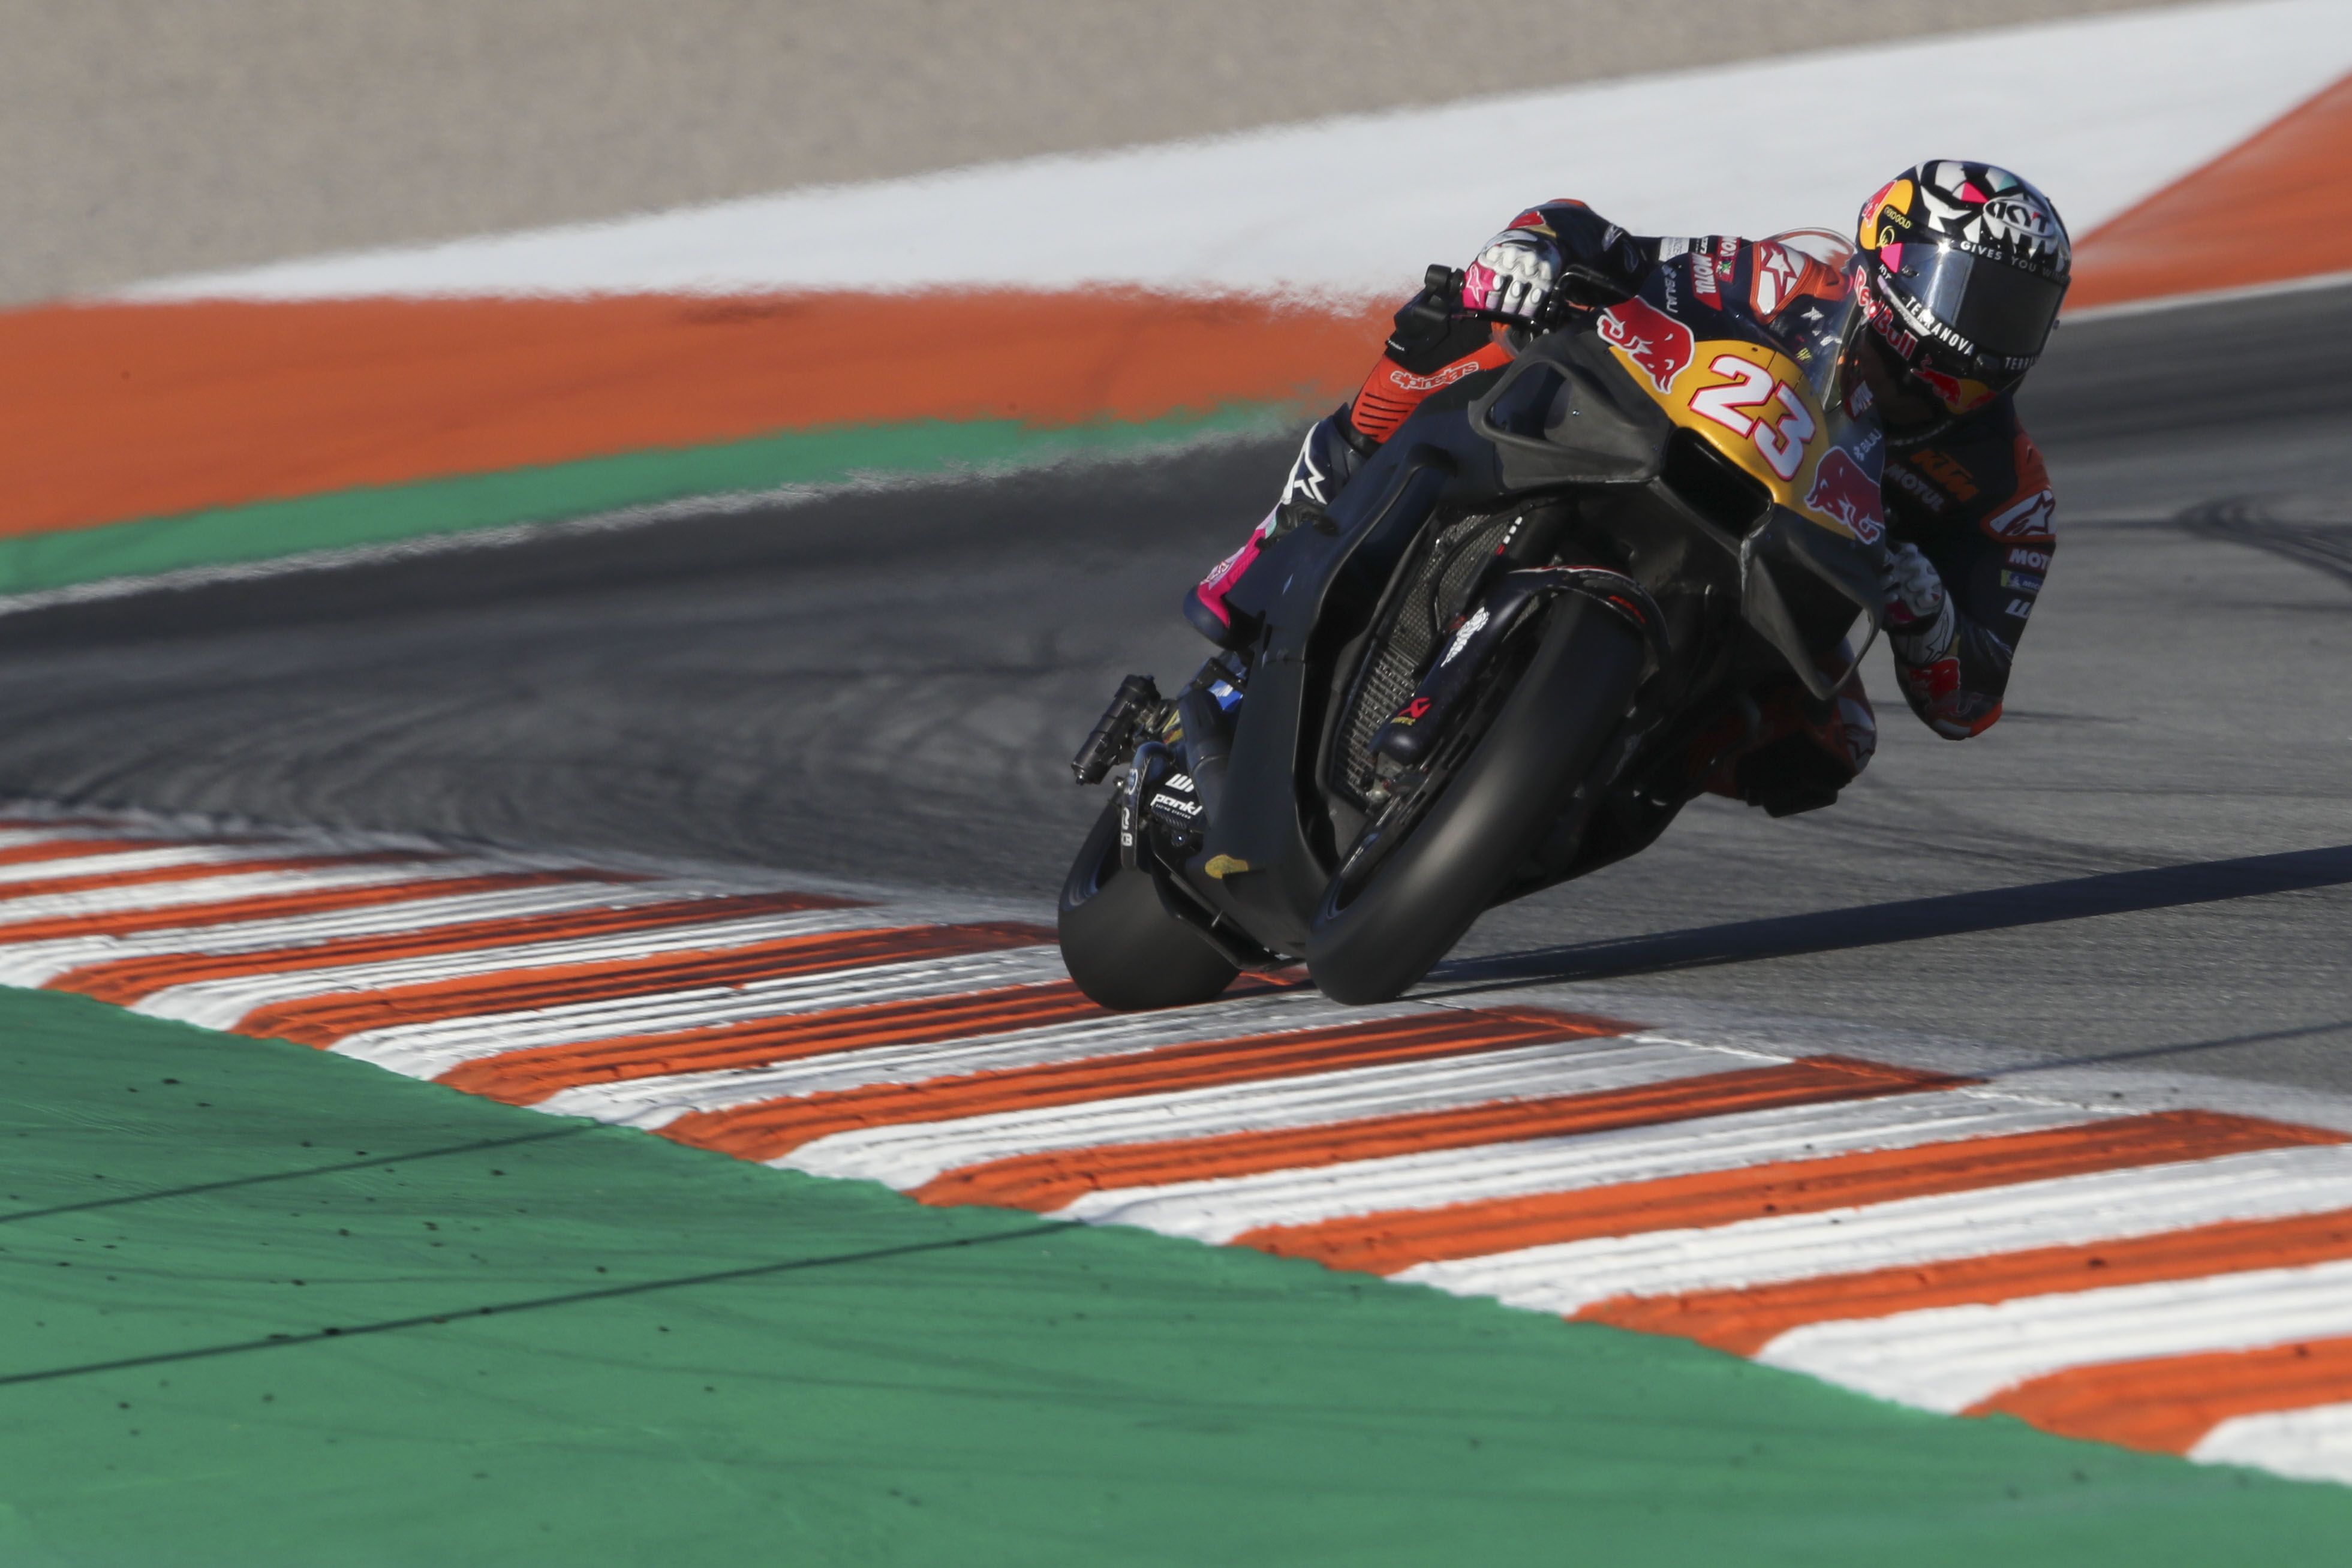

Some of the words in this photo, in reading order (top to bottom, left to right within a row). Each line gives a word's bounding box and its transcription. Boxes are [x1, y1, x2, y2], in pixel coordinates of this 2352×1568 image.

[1691, 252, 1716, 294] MOTUL
[1960, 241, 2003, 261] GIVES
[2011, 256, 2037, 272] YOU
[1854, 264, 1885, 321] Red
[1872, 305, 1918, 360] Bull
[1905, 296, 1974, 356] TERRANOVA
[1390, 361, 1479, 390] alpinestars
[1688, 354, 1816, 482] 23
[1885, 462, 1944, 513] MOTUL
[1910, 448, 1980, 502] KTM
[2008, 548, 2051, 571] MOT
[1150, 793, 1203, 816] pankl
